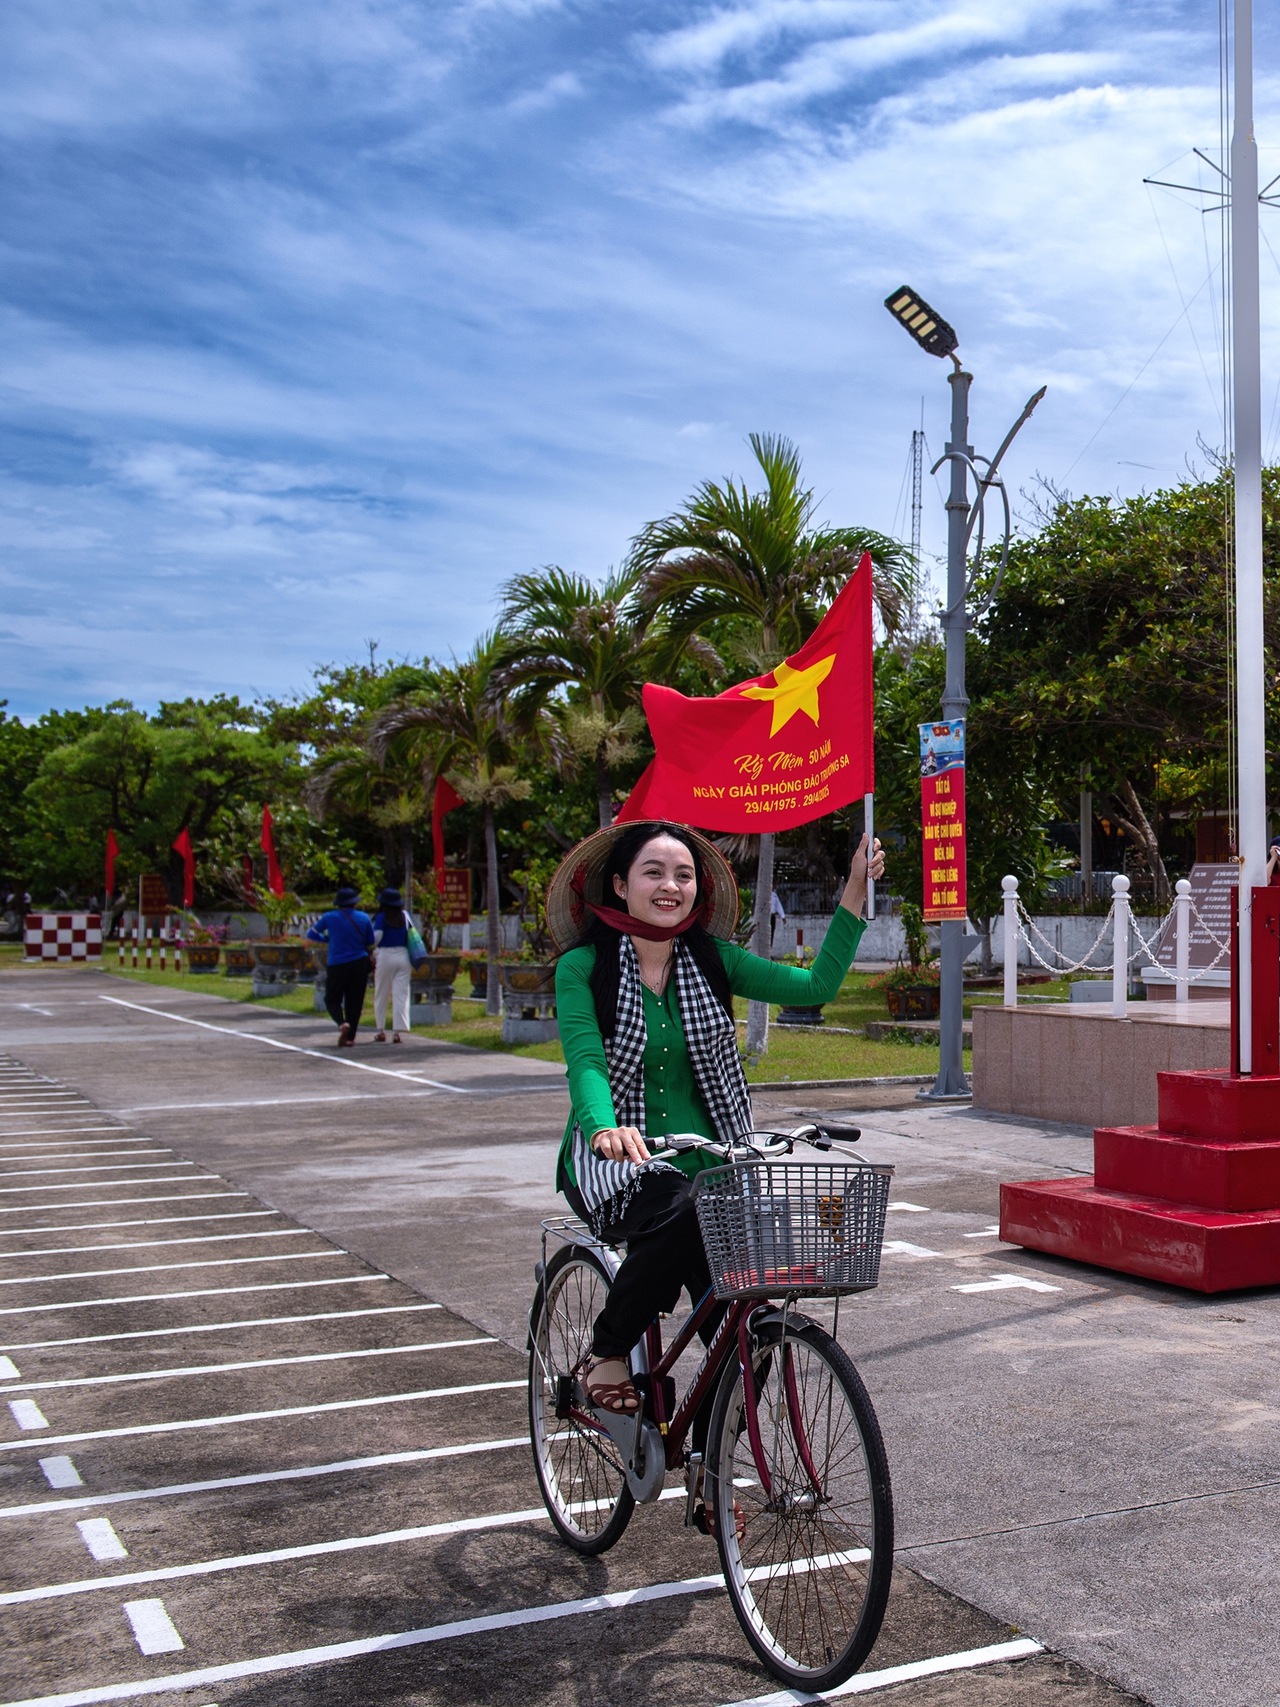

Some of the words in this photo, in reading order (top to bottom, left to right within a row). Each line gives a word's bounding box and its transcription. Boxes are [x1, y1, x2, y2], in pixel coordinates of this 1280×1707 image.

[768, 751, 804, 772] Niệm
[809, 748, 819, 765] 50
[819, 738, 832, 760] NĂM
[693, 785, 725, 799] NGÀY
[729, 782, 757, 798] GIẢI
[761, 779, 802, 796] PHÓNG
[803, 773, 820, 790] ĐẢO
[839, 753, 850, 769] SA
[744, 797, 797, 814] 29/4/1975
